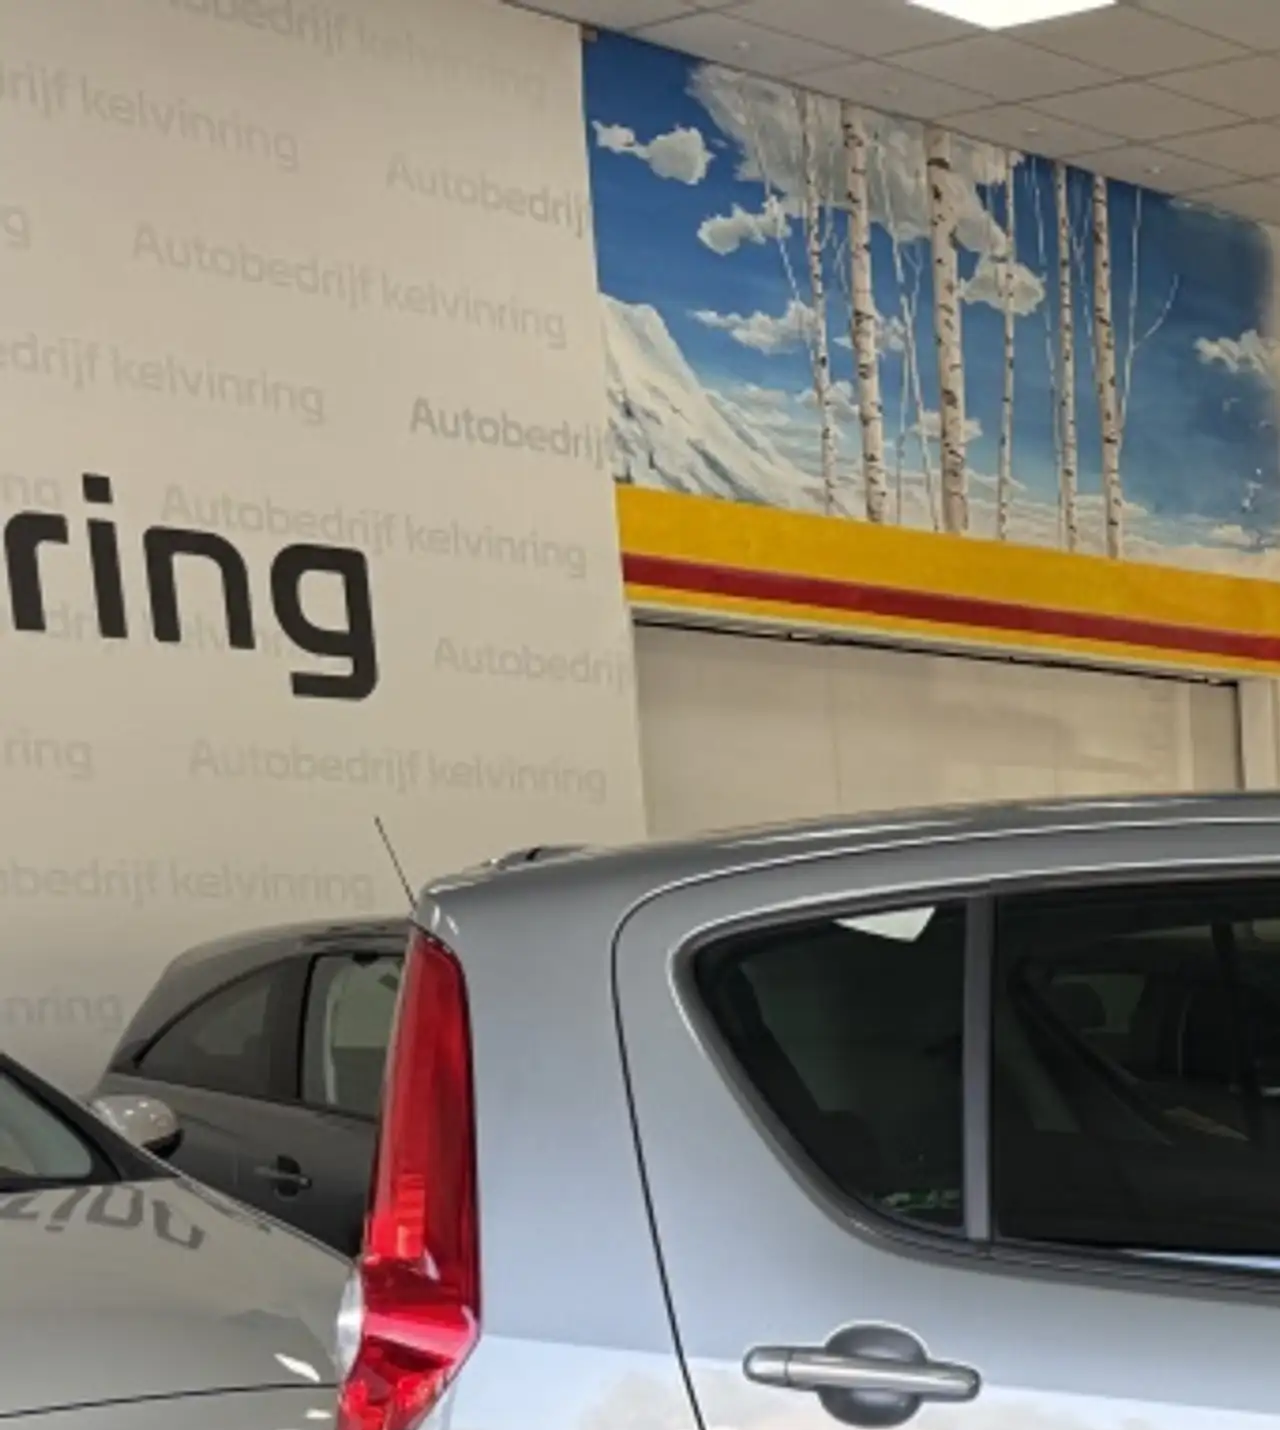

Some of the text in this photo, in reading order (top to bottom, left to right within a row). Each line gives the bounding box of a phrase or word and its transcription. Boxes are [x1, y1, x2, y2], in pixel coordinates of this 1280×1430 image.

[79, 73, 299, 174] kelvinring
[132, 219, 567, 350] Autobedrijf kelvinring
[0, 332, 325, 427] drijf kelvinring
[3, 472, 379, 702] ring
[402, 512, 588, 579] kelvinring
[188, 738, 421, 794] Autobedrijf
